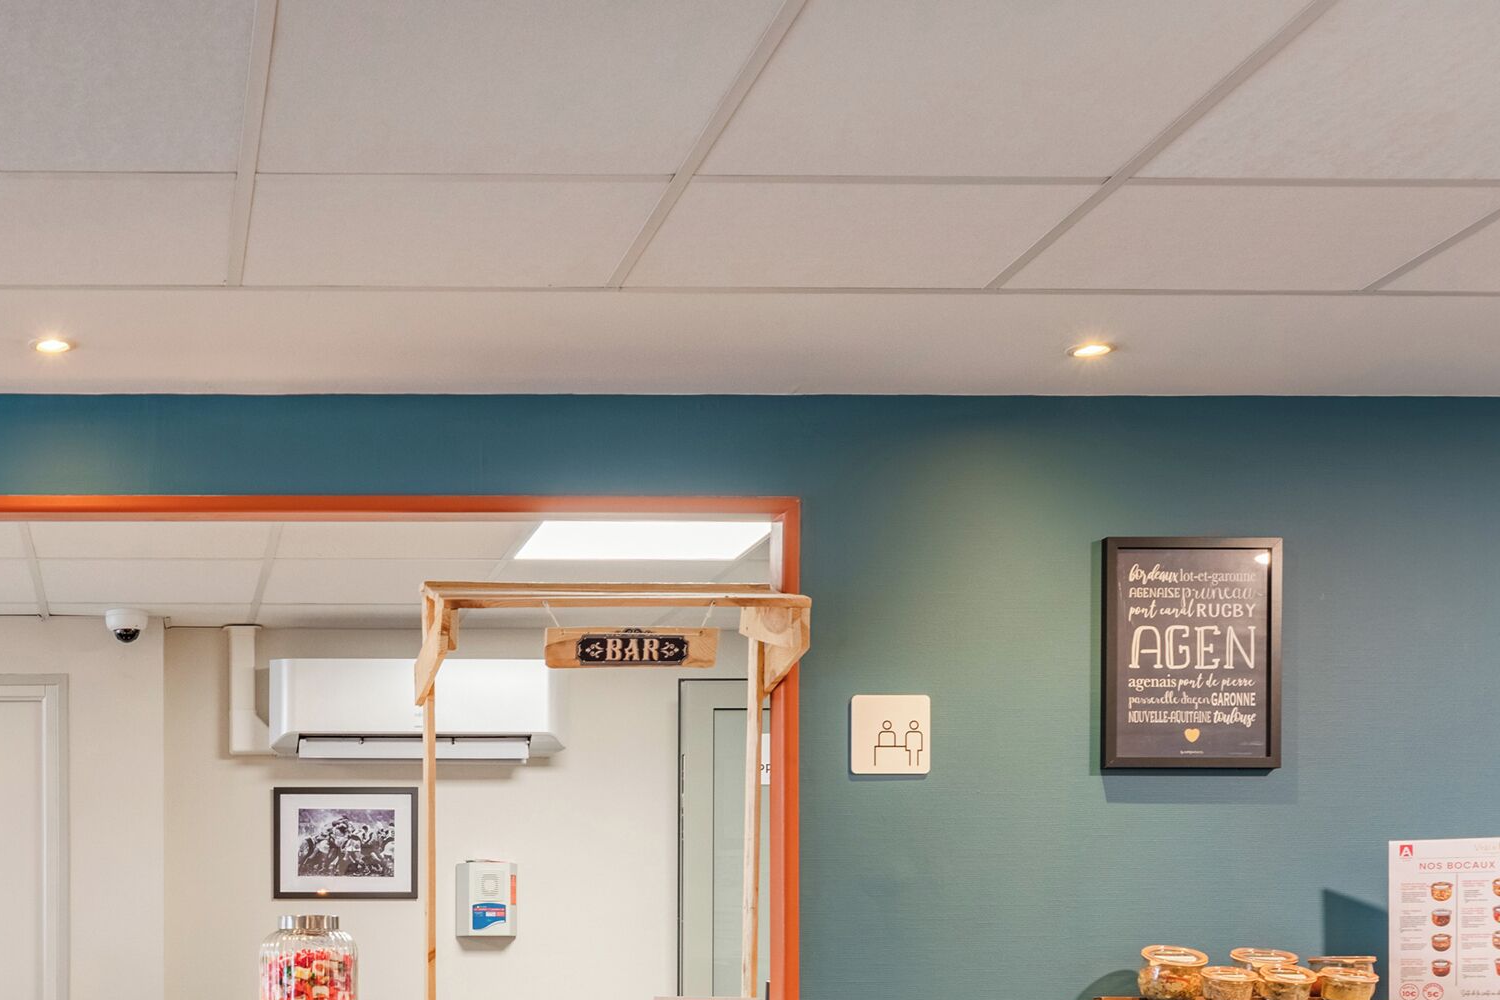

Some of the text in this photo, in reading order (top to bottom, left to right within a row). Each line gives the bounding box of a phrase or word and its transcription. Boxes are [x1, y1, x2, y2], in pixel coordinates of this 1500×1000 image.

[1128, 563, 1257, 586] bordeaux lot-et-garonne
[1129, 587, 1261, 607] AGENAISE pruneau
[1128, 598, 1257, 622] pont canal RUGBY
[605, 638, 661, 662] BAR
[1128, 624, 1257, 670] AGEN
[1128, 672, 1256, 692] agenais pont de pierre
[1128, 690, 1180, 709] passerelle
[1211, 692, 1257, 707] GARONNE
[1128, 707, 1257, 728] NOUVELLE-AQUITAINE toulouse
[1419, 861, 1496, 870] NOS BOCAUX
